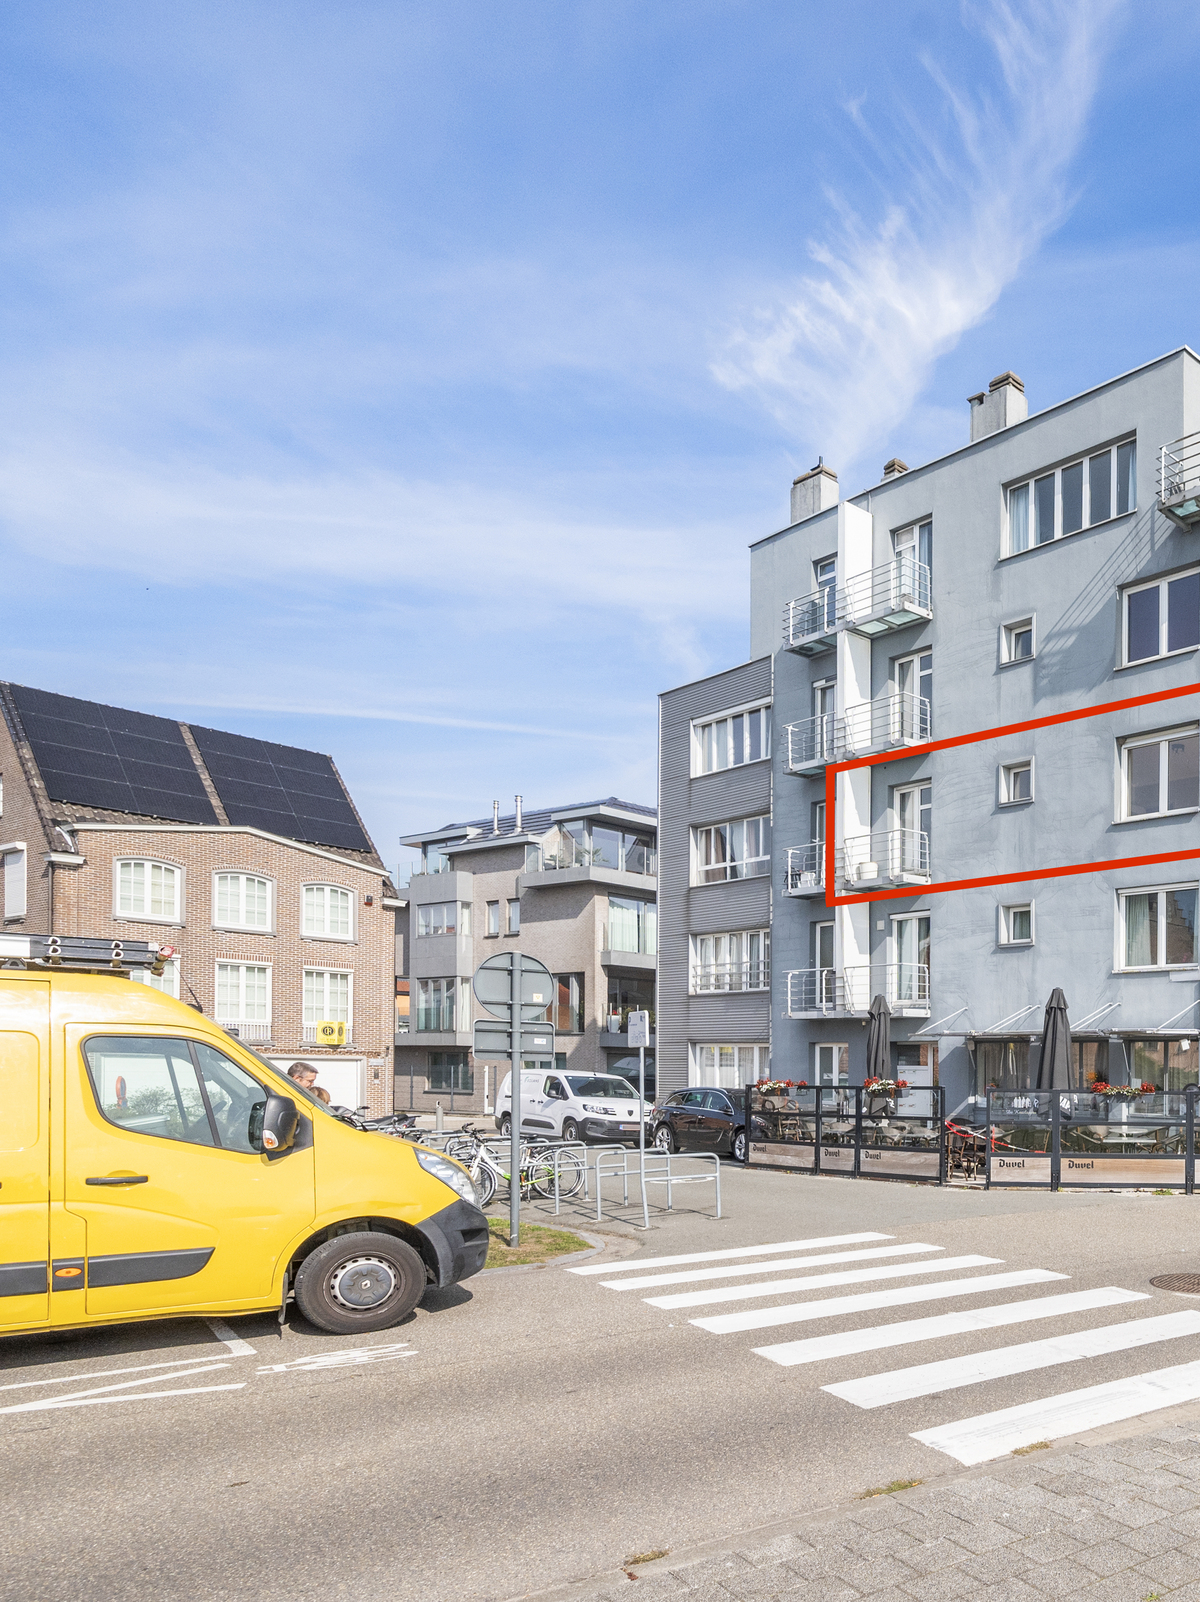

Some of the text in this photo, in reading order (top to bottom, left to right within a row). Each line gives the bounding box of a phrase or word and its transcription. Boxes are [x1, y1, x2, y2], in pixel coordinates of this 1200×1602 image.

[824, 1148, 840, 1157] Duvel
[865, 1151, 881, 1159] Duvel
[998, 1158, 1025, 1168] Duvel
[1068, 1160, 1094, 1169] Duvel
